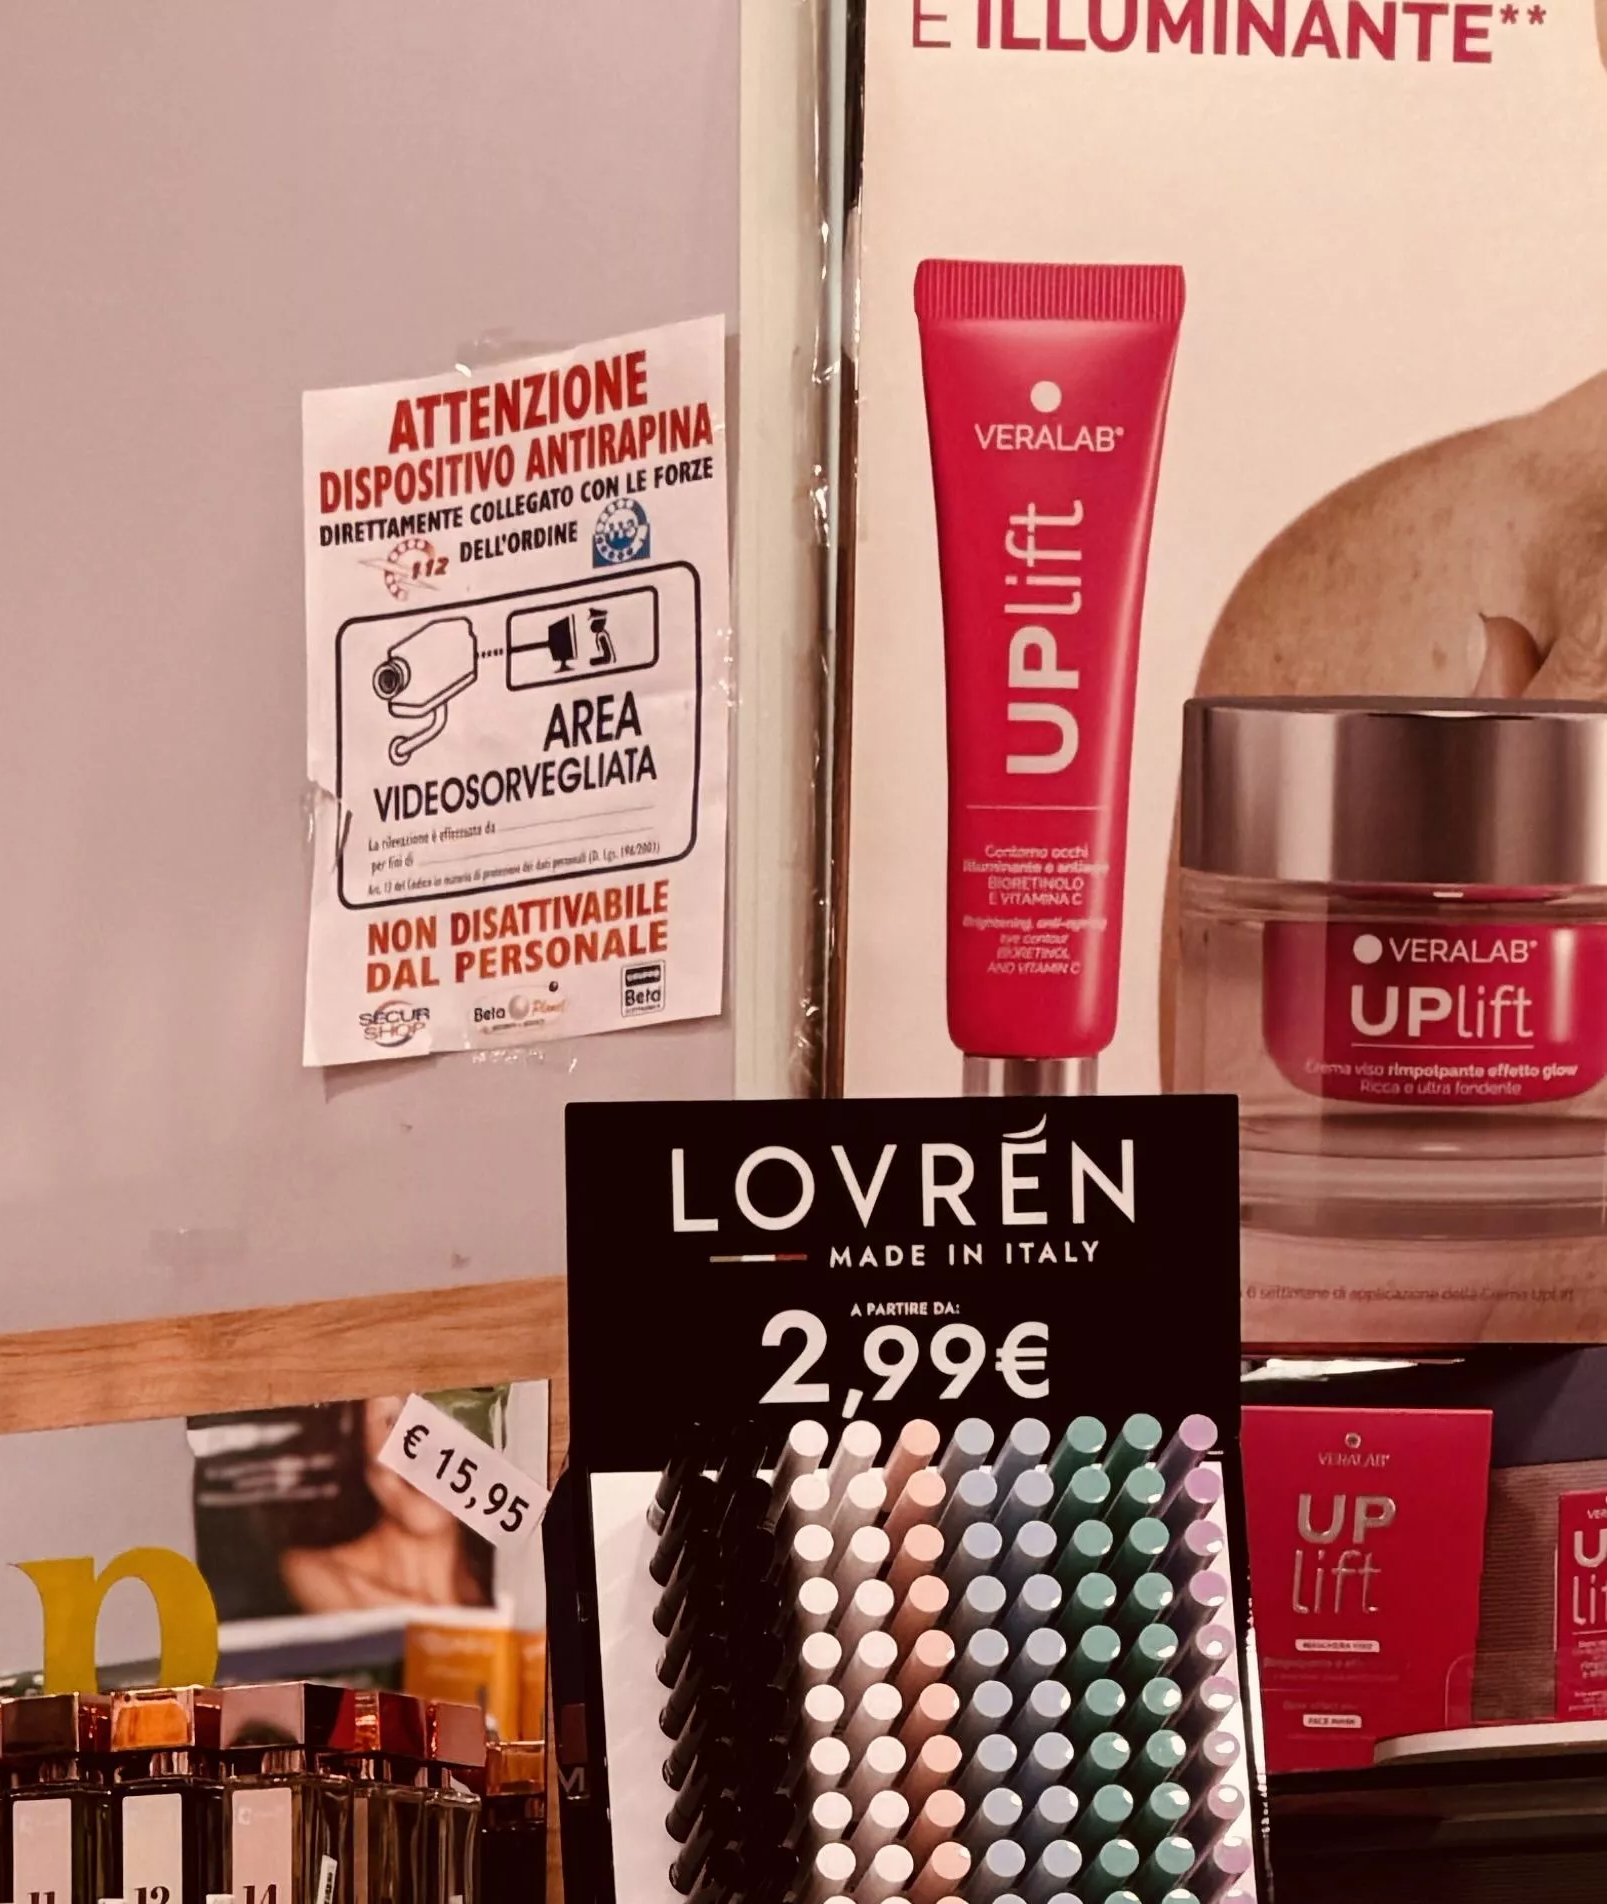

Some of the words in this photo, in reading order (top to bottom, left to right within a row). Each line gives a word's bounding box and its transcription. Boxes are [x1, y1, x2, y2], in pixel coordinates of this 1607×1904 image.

[913, 0, 951, 48] E
[388, 350, 647, 454] ATTENZIONE
[320, 445, 514, 514] DISPOSITIVO
[526, 402, 713, 481] ANTIRAPINA
[320, 507, 463, 547] DIRETTAMENTE
[470, 485, 573, 525] COLLEGATO
[581, 475, 619, 504] CON
[626, 470, 647, 494] LE
[654, 457, 713, 487] FORZE
[412, 557, 449, 580] 112
[460, 521, 578, 563] DELL'ORDINE
[1005, 499, 1083, 775] UPlift
[543, 692, 642, 752] AREA
[373, 753, 658, 823] VIDEOSORVEGLIATA
[368, 915, 438, 956] NON
[450, 879, 669, 946] DISATTIVABILE
[366, 956, 440, 994] DAL
[455, 920, 668, 983] PERSONALE
[474, 1007, 505, 1022] Beta
[625, 989, 661, 1007] Beta
[1350, 984, 1534, 1038] UPlift
[671, 1113, 1135, 1233] LOVRÉN
[830, 1245, 927, 1269] MADE
[948, 1243, 984, 1267] IN
[1006, 1240, 1099, 1265] ITALY
[850, 1303, 862, 1317] A
[867, 1302, 928, 1317] PARTIRE
[934, 1302, 960, 1316] DA:
[759, 1309, 1050, 1419] 2,99€
[401, 1423, 430, 1461] €
[435, 1445, 532, 1534] 15,95
[1298, 1493, 1396, 1544] UP
[1292, 1549, 1381, 1614] lift
